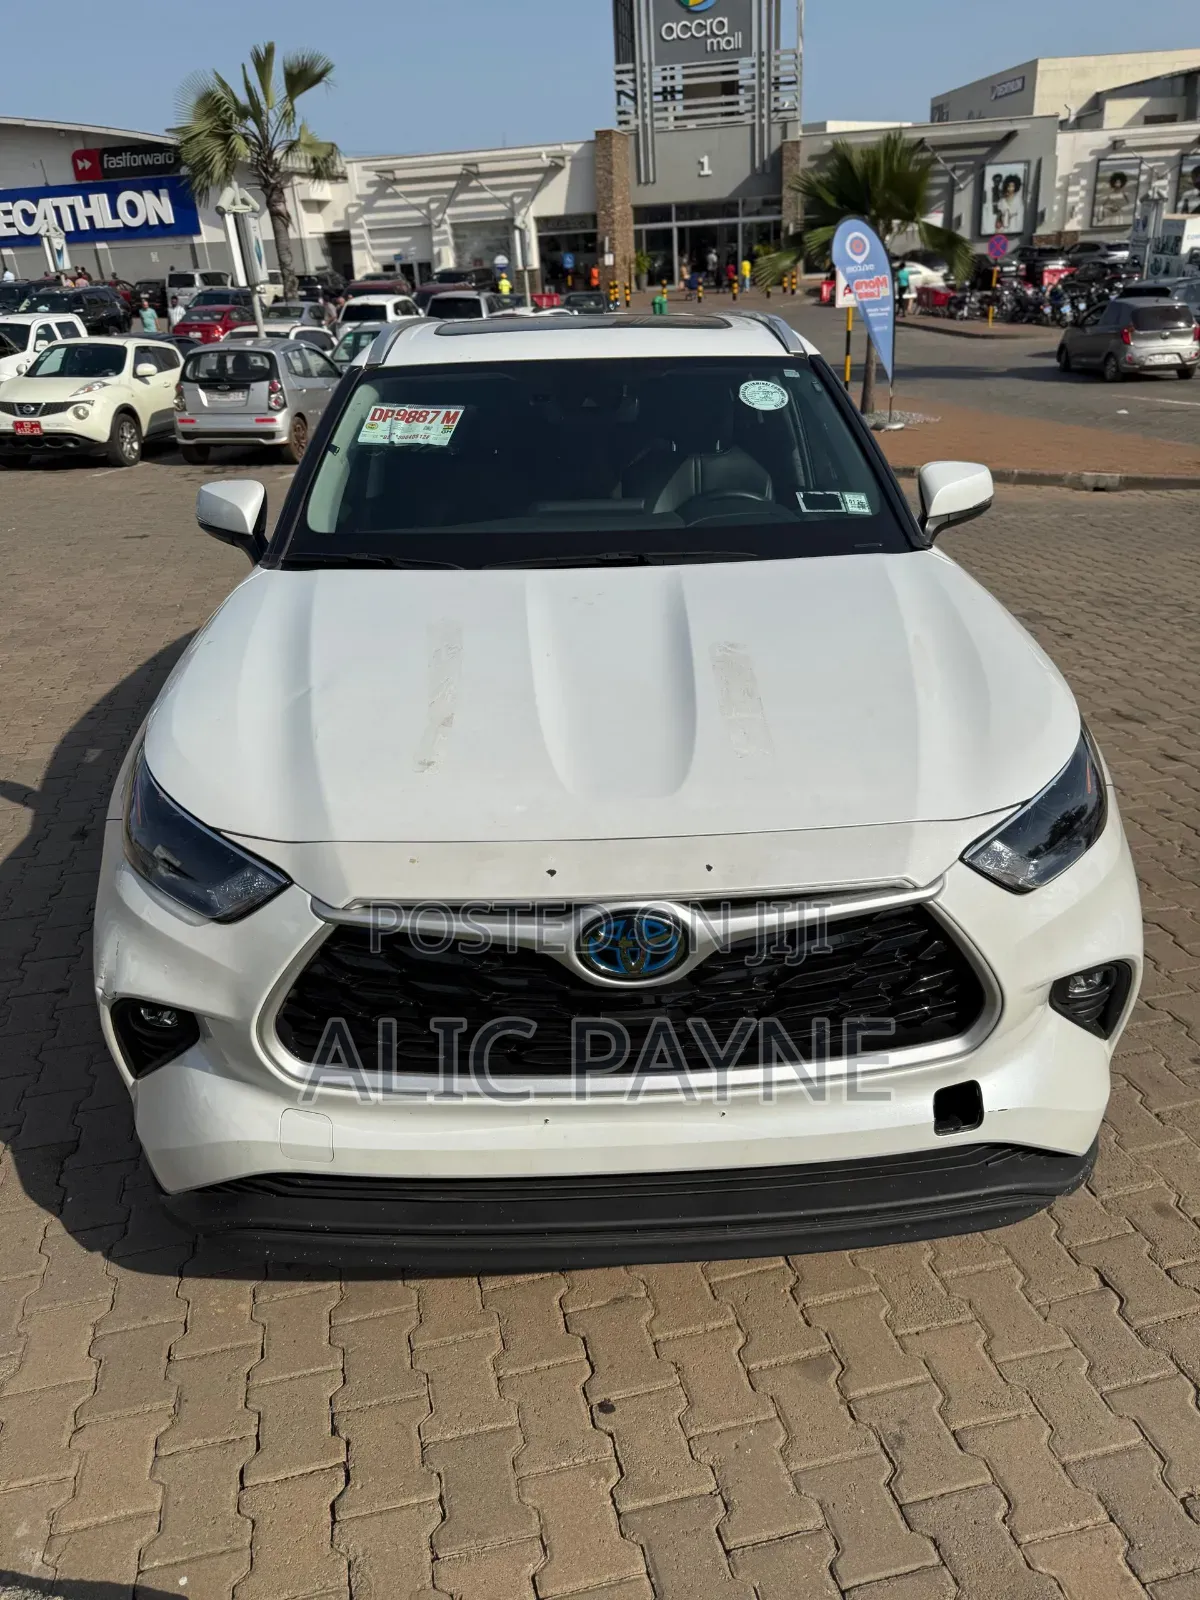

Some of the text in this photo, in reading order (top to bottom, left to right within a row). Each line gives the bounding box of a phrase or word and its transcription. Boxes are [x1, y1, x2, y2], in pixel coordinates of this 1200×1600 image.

[661, 17, 728, 41] accra
[706, 32, 742, 51] mall
[103, 151, 175, 169] fastforward
[699, 155, 712, 176] 1
